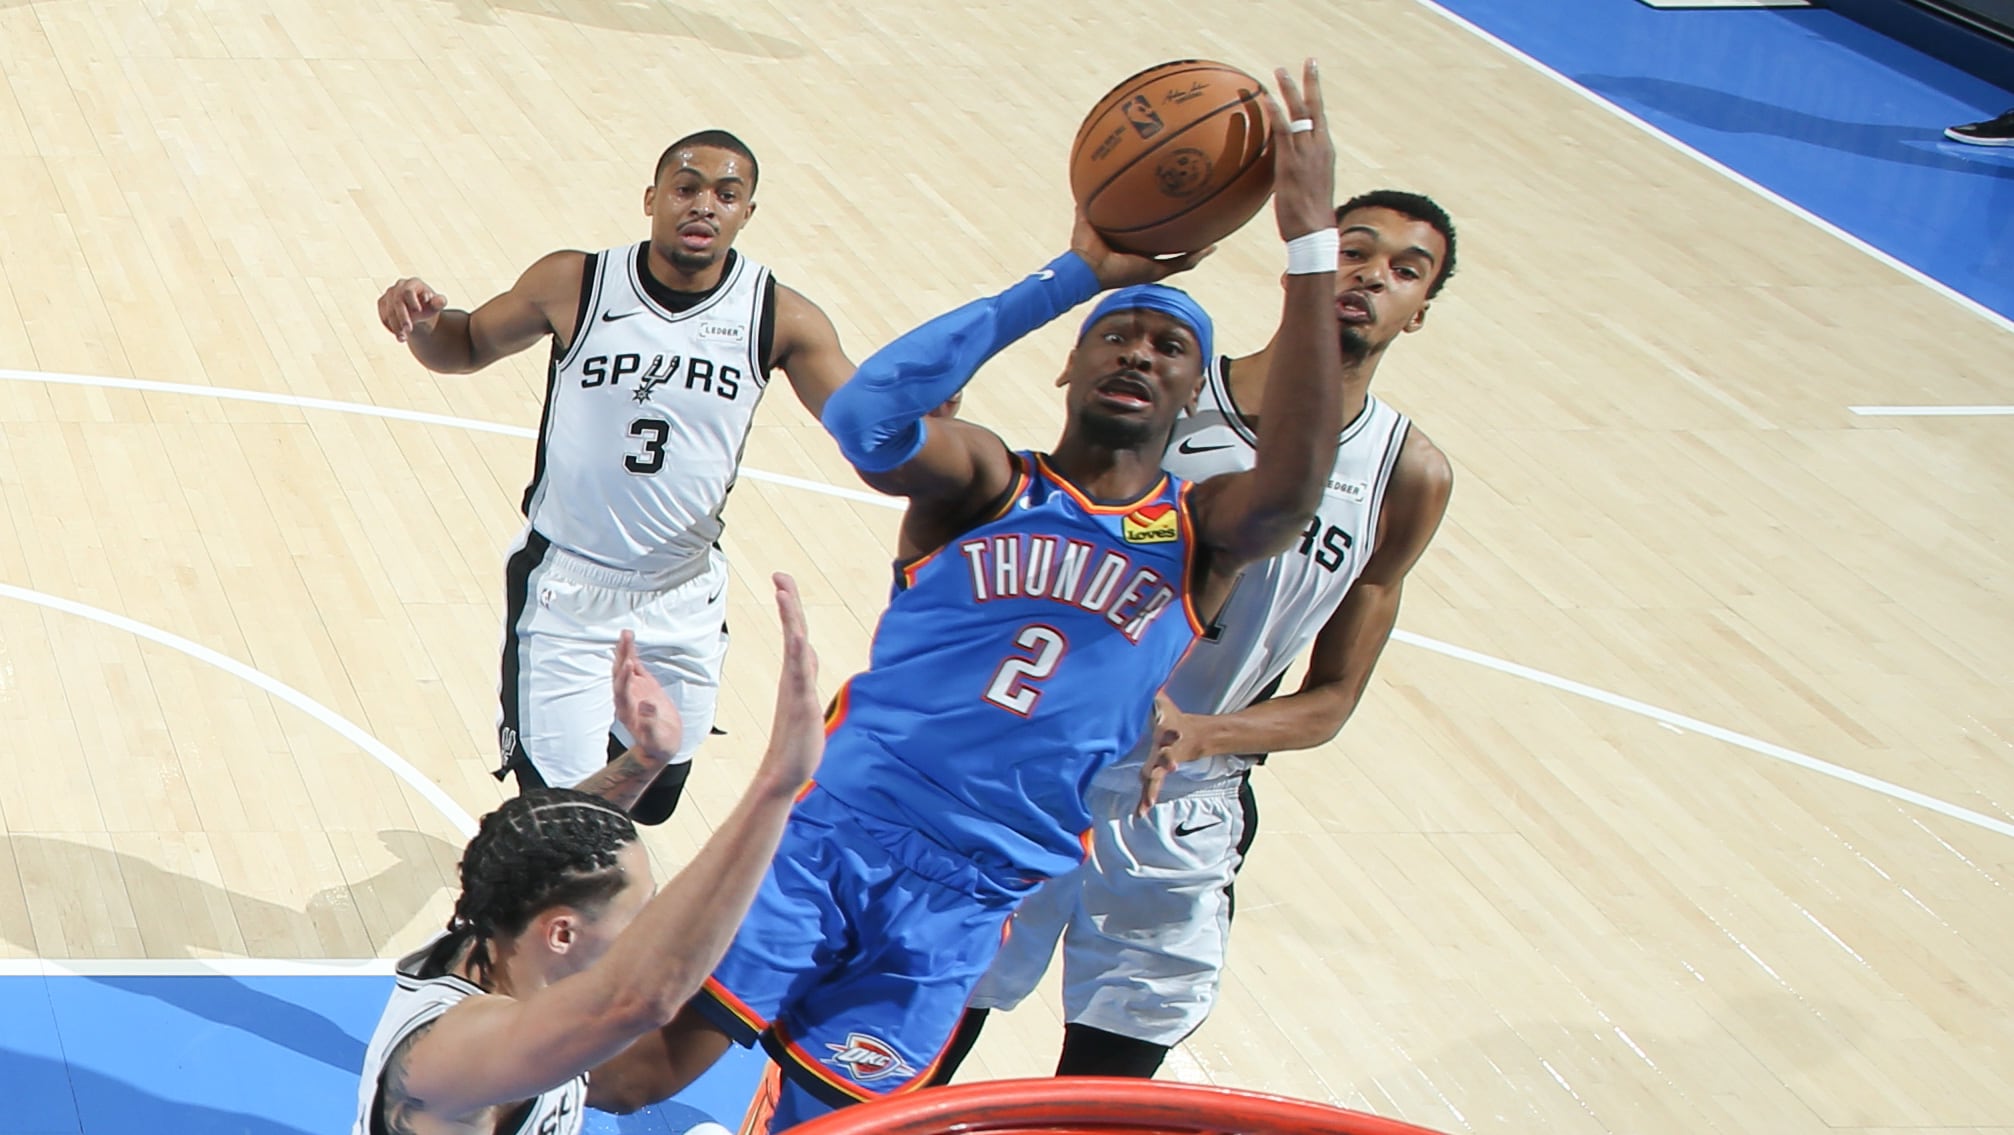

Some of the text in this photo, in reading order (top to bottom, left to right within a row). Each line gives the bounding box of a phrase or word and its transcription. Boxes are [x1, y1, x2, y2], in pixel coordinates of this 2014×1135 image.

[624, 418, 671, 475] 3
[1324, 480, 1360, 495] EDGER
[961, 534, 1175, 646] THUNDER
[982, 623, 1069, 719] 2
